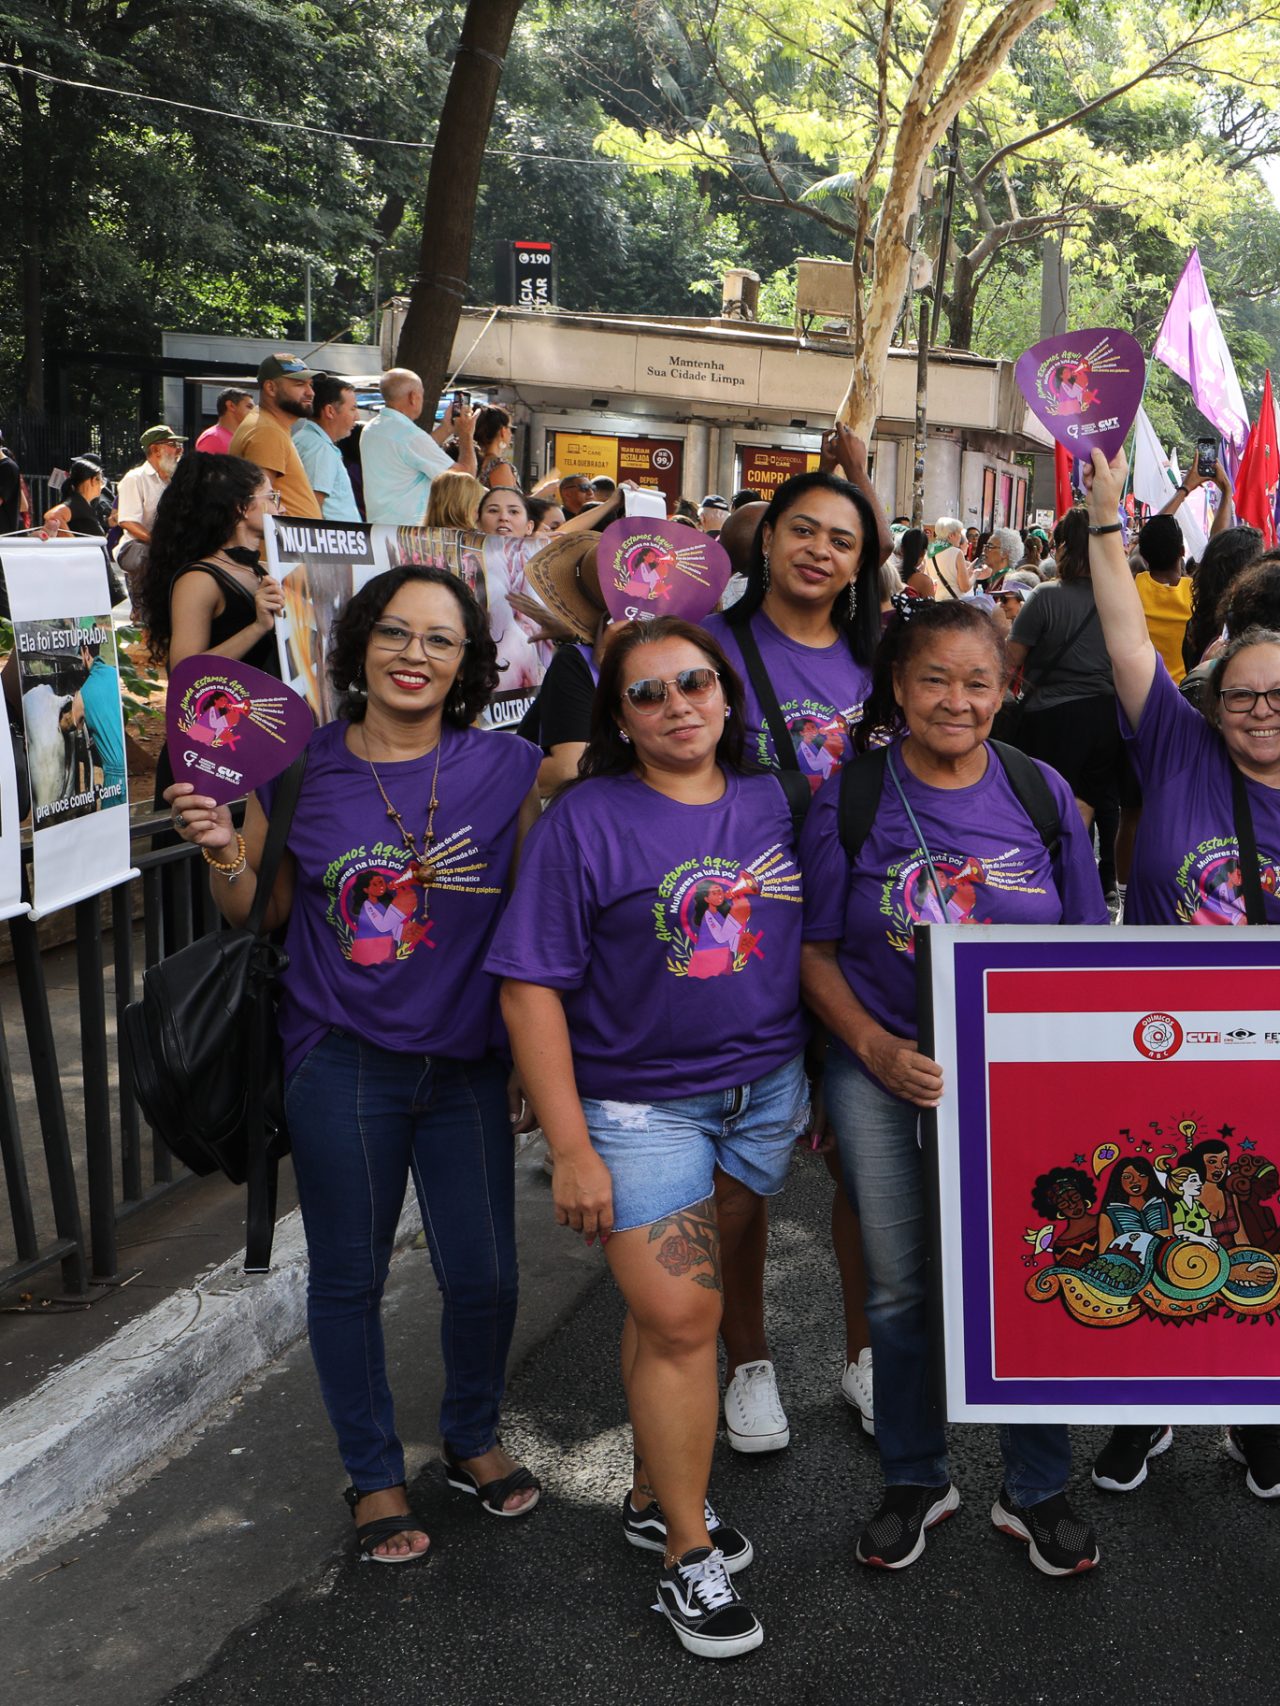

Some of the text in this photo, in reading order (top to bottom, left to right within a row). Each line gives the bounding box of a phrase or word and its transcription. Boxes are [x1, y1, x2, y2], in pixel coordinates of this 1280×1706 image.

[530, 253, 550, 265] 190
[669, 356, 725, 371] Mantenha
[647, 366, 745, 386] Sua Cidade Limpa
[1098, 417, 1119, 428] CUT
[747, 469, 791, 484] COMPRA
[281, 526, 367, 556] MULHERES
[20, 627, 108, 653] Ela foi ESTUPRADA
[802, 699, 836, 715] Aqui!
[217, 766, 244, 779] CUT
[36, 804, 50, 823] pra
[50, 794, 69, 814] você
[70, 791, 94, 810] comer
[323, 846, 367, 888] Estamos
[372, 842, 413, 864] Aqui!
[355, 859, 405, 871] na luta por
[1176, 852, 1197, 888] Ainda
[1197, 850, 1231, 870] Mulheres
[896, 861, 919, 890] Mulheres
[948, 857, 964, 866] por
[651, 855, 741, 942] Ainda Estamos Aqui!
[669, 868, 737, 914] Mulheres na luta por
[761, 885, 781, 893] Justiça
[879, 880, 895, 916] Ainda
[1142, 1014, 1174, 1027] QUÍMICOS
[1187, 1032, 1218, 1043] CUT
